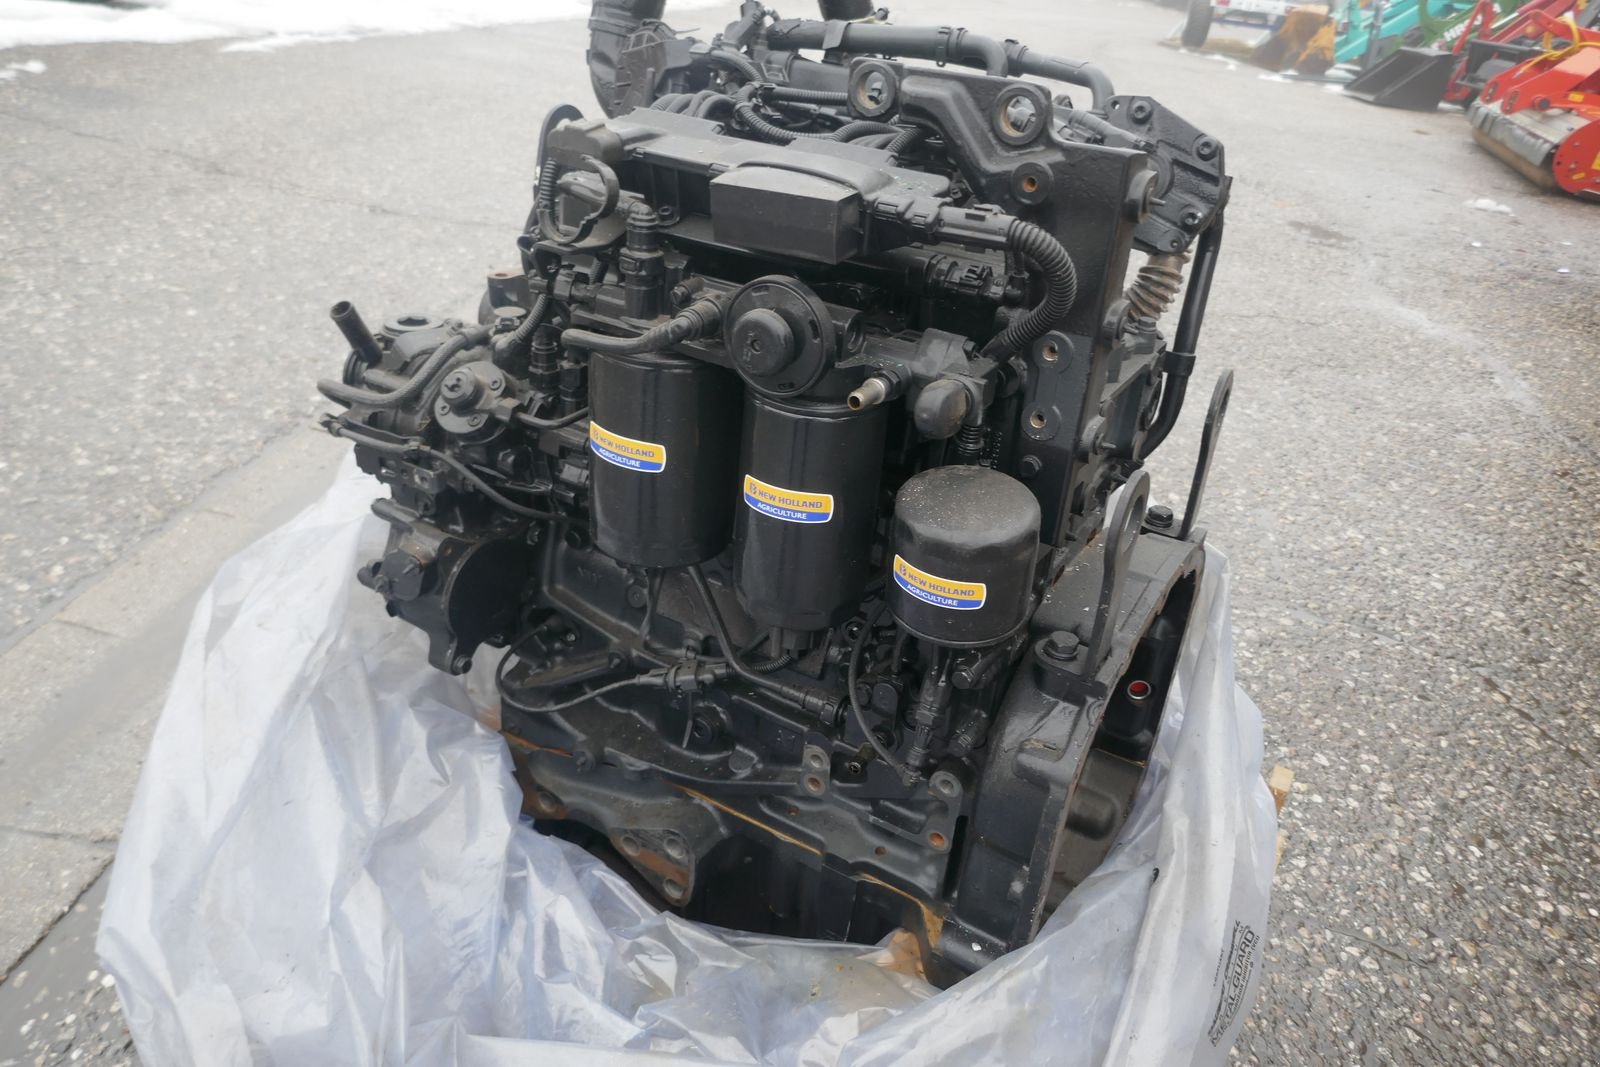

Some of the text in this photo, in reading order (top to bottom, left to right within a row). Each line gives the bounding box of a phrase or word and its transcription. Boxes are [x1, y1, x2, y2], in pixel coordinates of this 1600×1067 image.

[599, 447, 641, 467] AGRICULTURE
[600, 437, 655, 458] NEW HOLLAND
[758, 490, 823, 509] NEW HOLLAND
[757, 502, 807, 519] AGRICULTURE
[908, 572, 975, 596] NEW HOLLAND
[906, 584, 959, 606] AGRICULTURE
